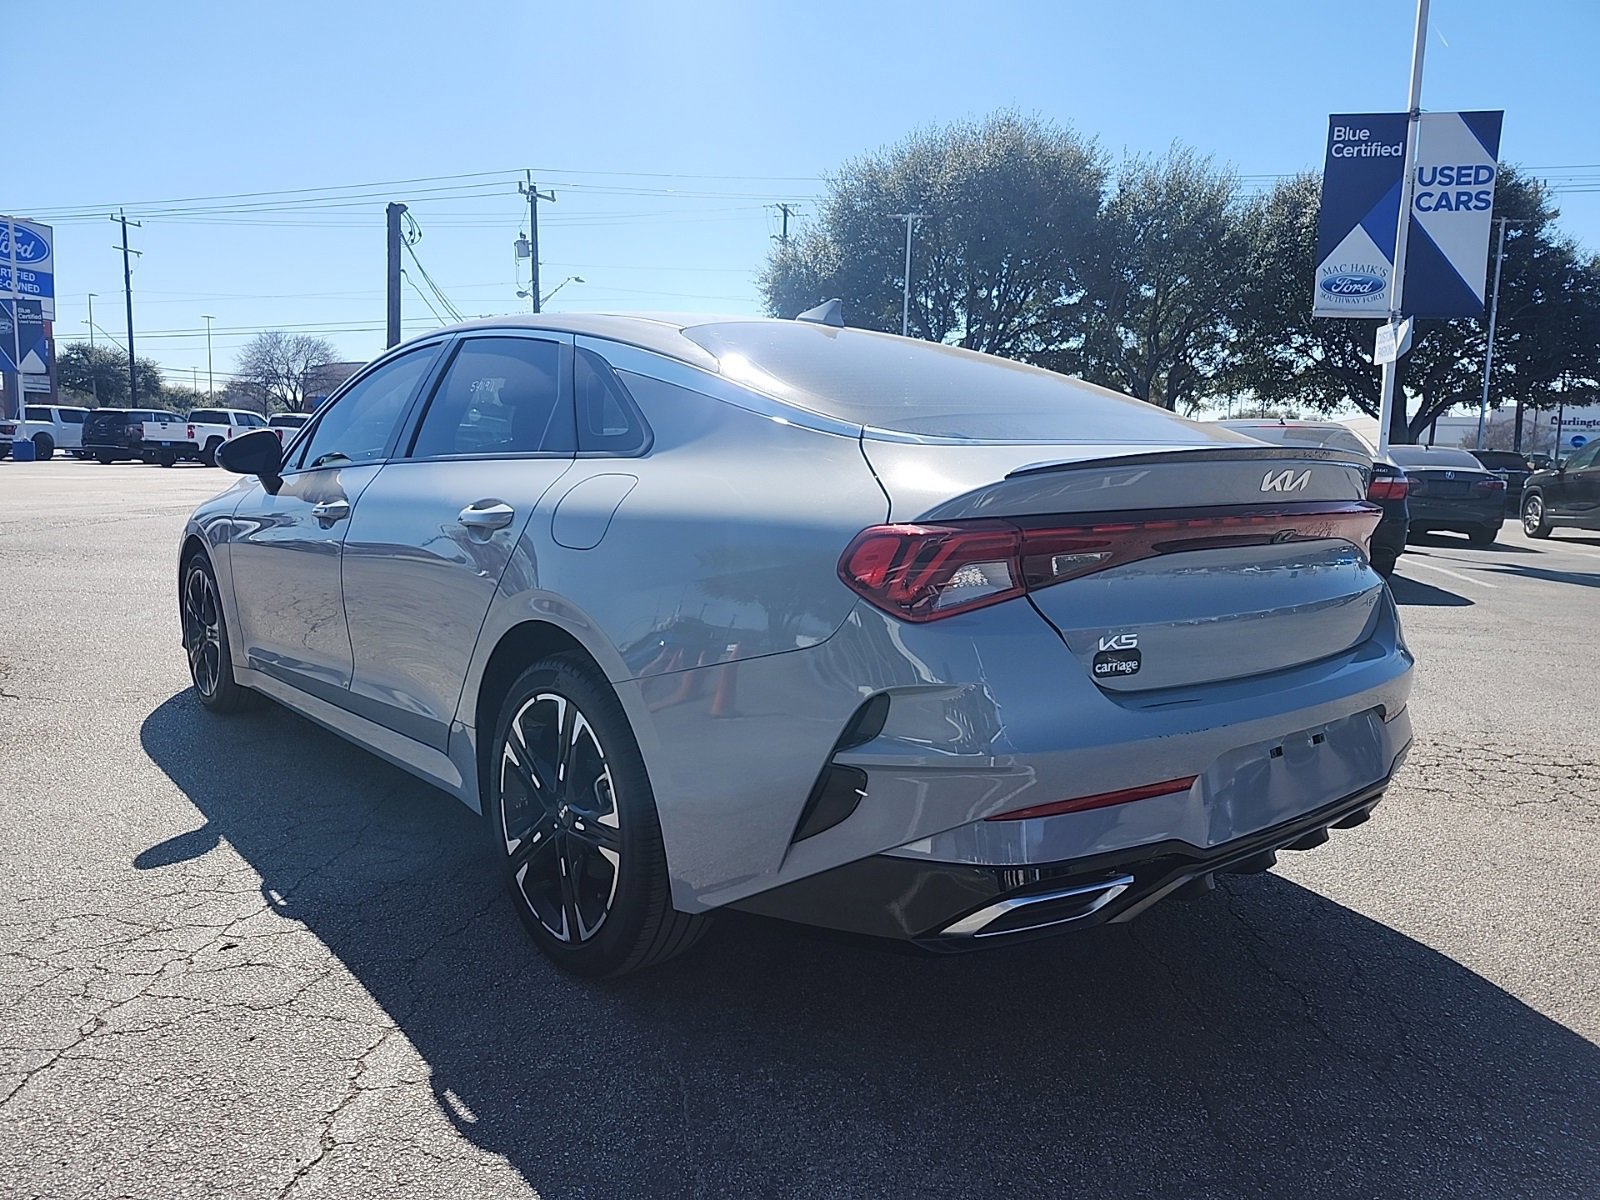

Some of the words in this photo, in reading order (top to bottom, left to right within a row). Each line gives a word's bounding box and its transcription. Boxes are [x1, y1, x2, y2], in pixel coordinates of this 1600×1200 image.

[1333, 126, 1370, 141] Blue
[1332, 142, 1403, 158] Certified
[1417, 165, 1495, 187] USED
[1415, 190, 1492, 212] CARS
[0, 267, 36, 282] RTFIED
[1322, 263, 1347, 276] MAC
[1351, 263, 1388, 278] HAIK'S
[1331, 276, 1374, 293] Ford
[1320, 292, 1360, 304] SOUTHWAY
[1363, 293, 1385, 304] FORD
[1260, 470, 1312, 491] KIA
[1099, 633, 1138, 651] K5
[1095, 659, 1139, 673] carriage
